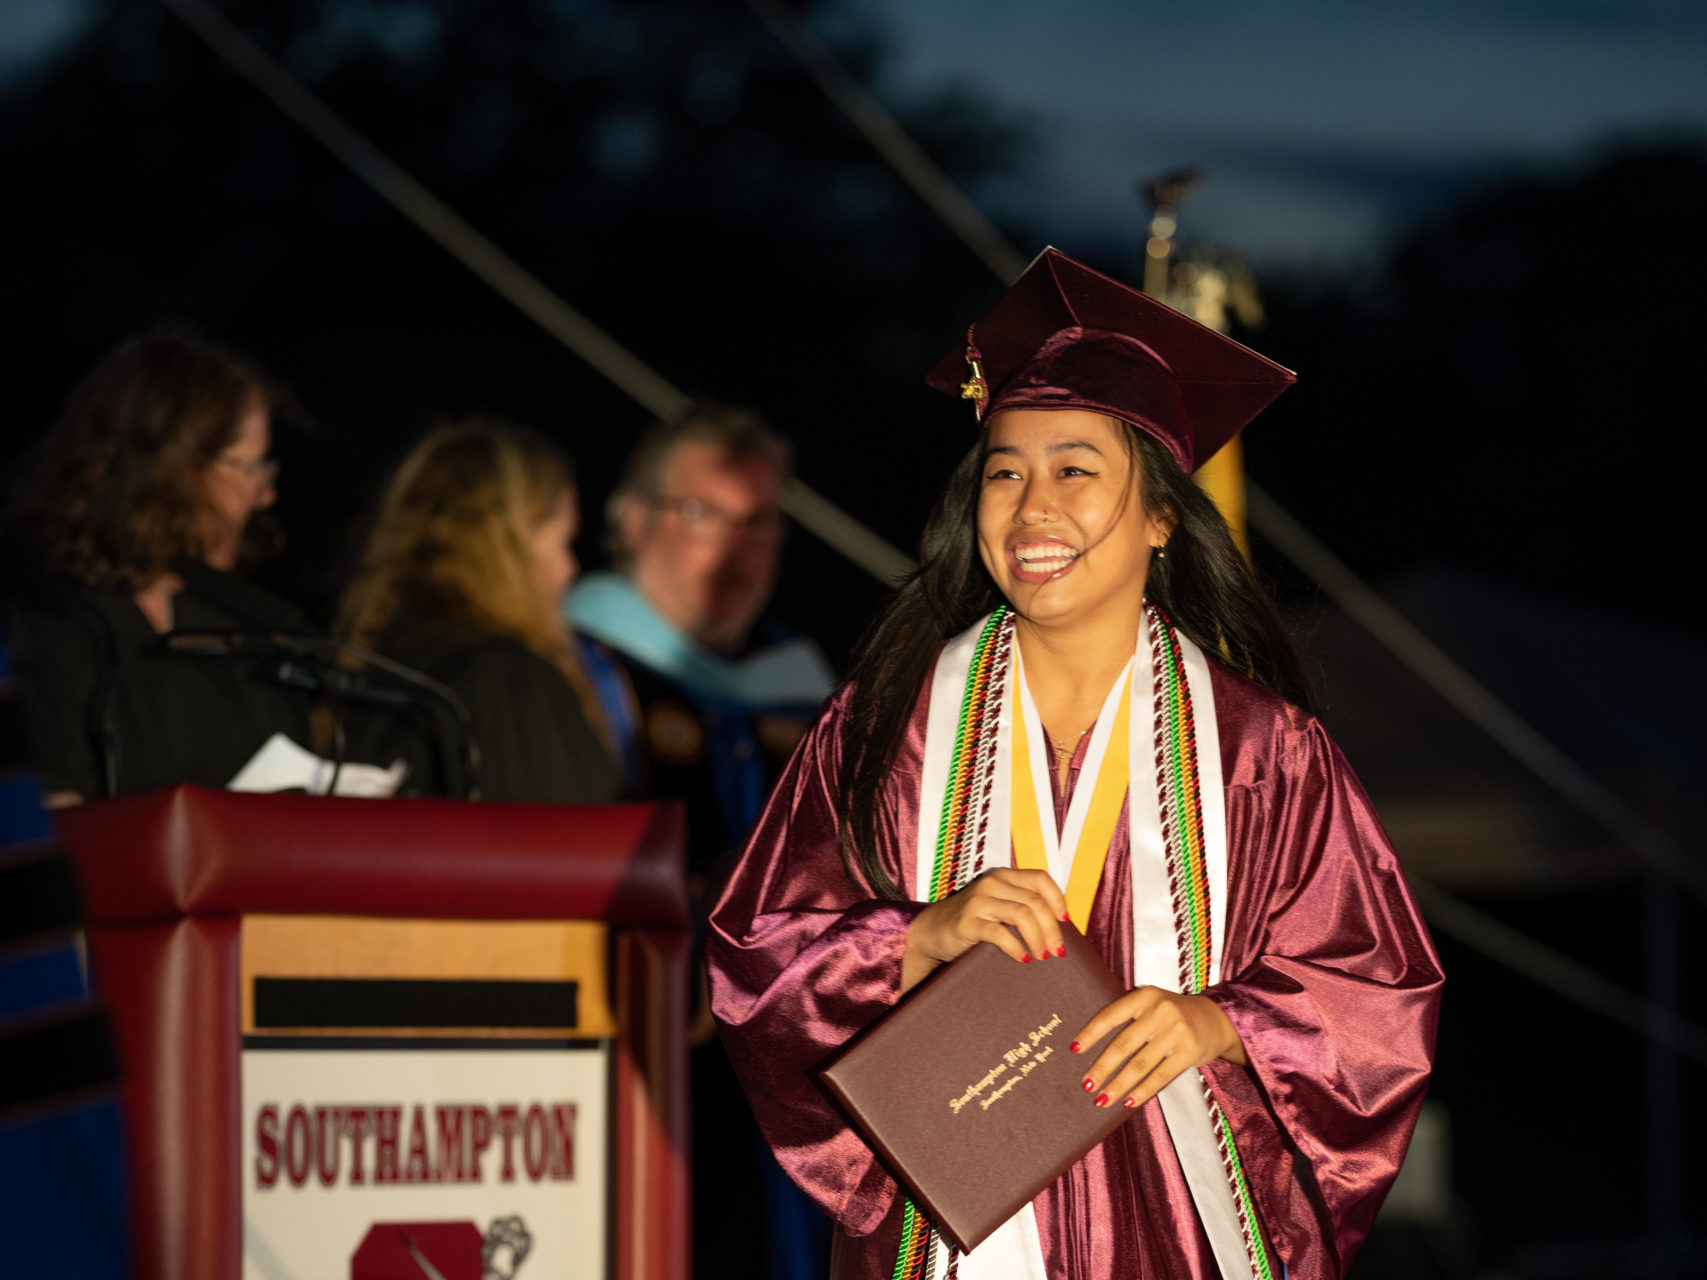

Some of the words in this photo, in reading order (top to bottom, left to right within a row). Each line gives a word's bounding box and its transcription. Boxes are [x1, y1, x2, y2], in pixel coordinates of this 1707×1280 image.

[949, 1064, 1008, 1115] Southampton
[1003, 1042, 1033, 1068] High
[1028, 1014, 1063, 1047] School
[256, 1103, 578, 1190] SOUTHAMPTON
